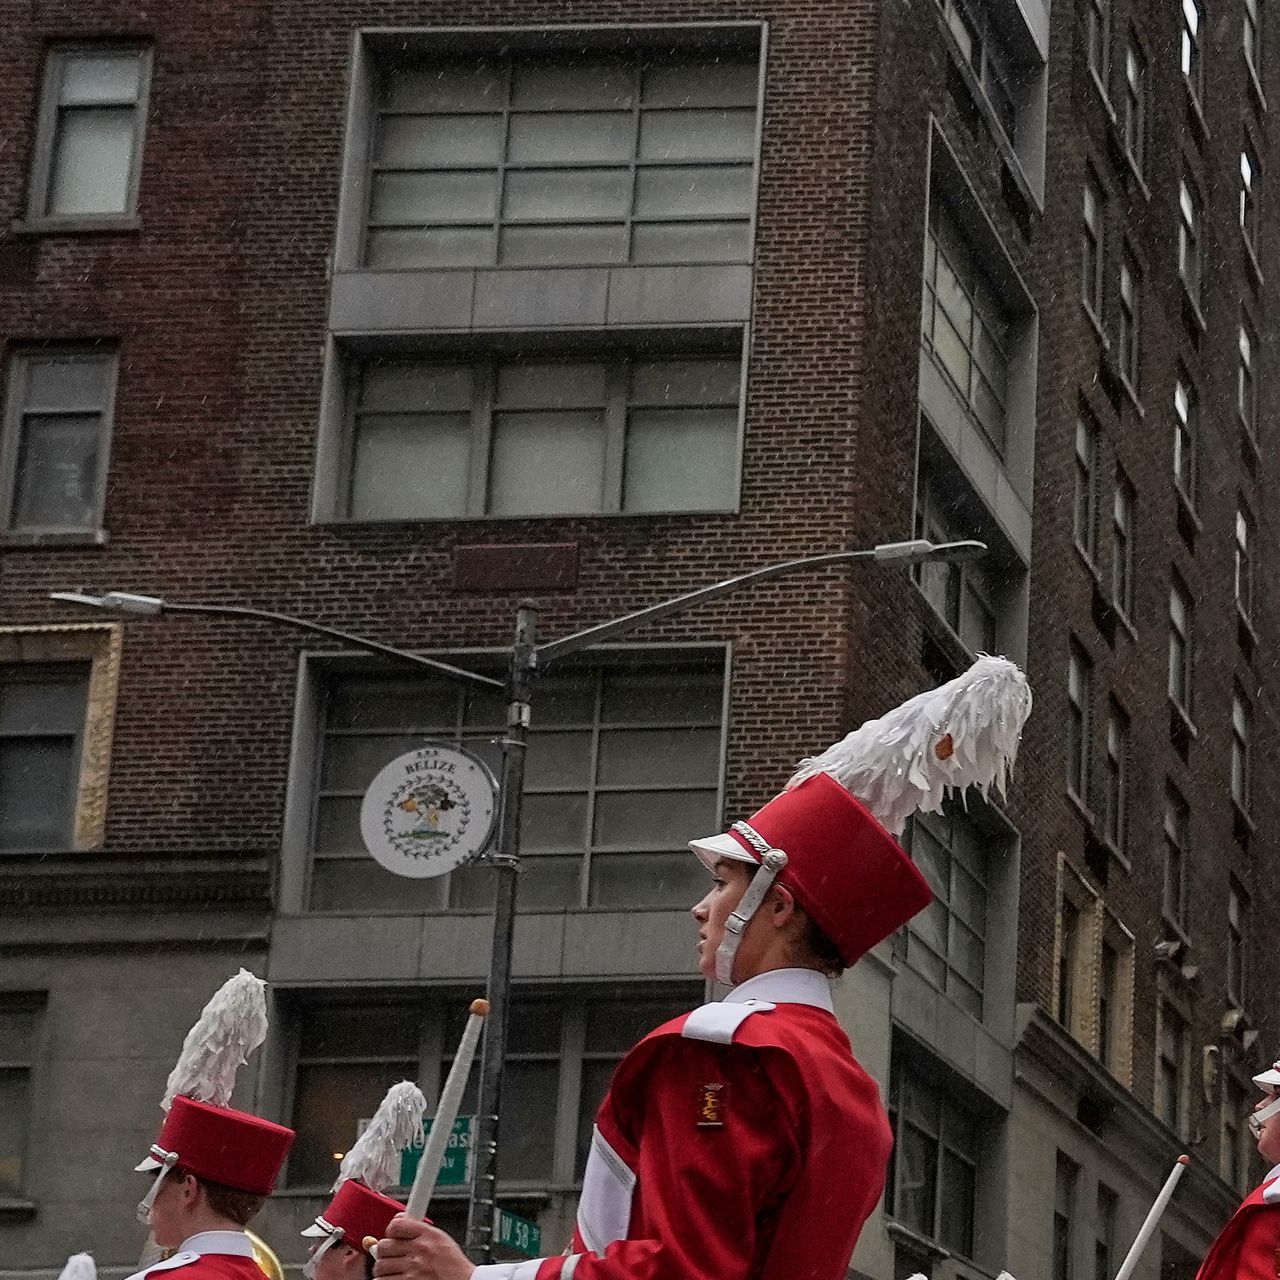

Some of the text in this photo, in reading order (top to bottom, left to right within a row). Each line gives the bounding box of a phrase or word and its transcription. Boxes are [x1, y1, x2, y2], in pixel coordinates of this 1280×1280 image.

[405, 760, 457, 774] BELIZE
[501, 1215, 512, 1242] W
[515, 1221, 529, 1249] 58
